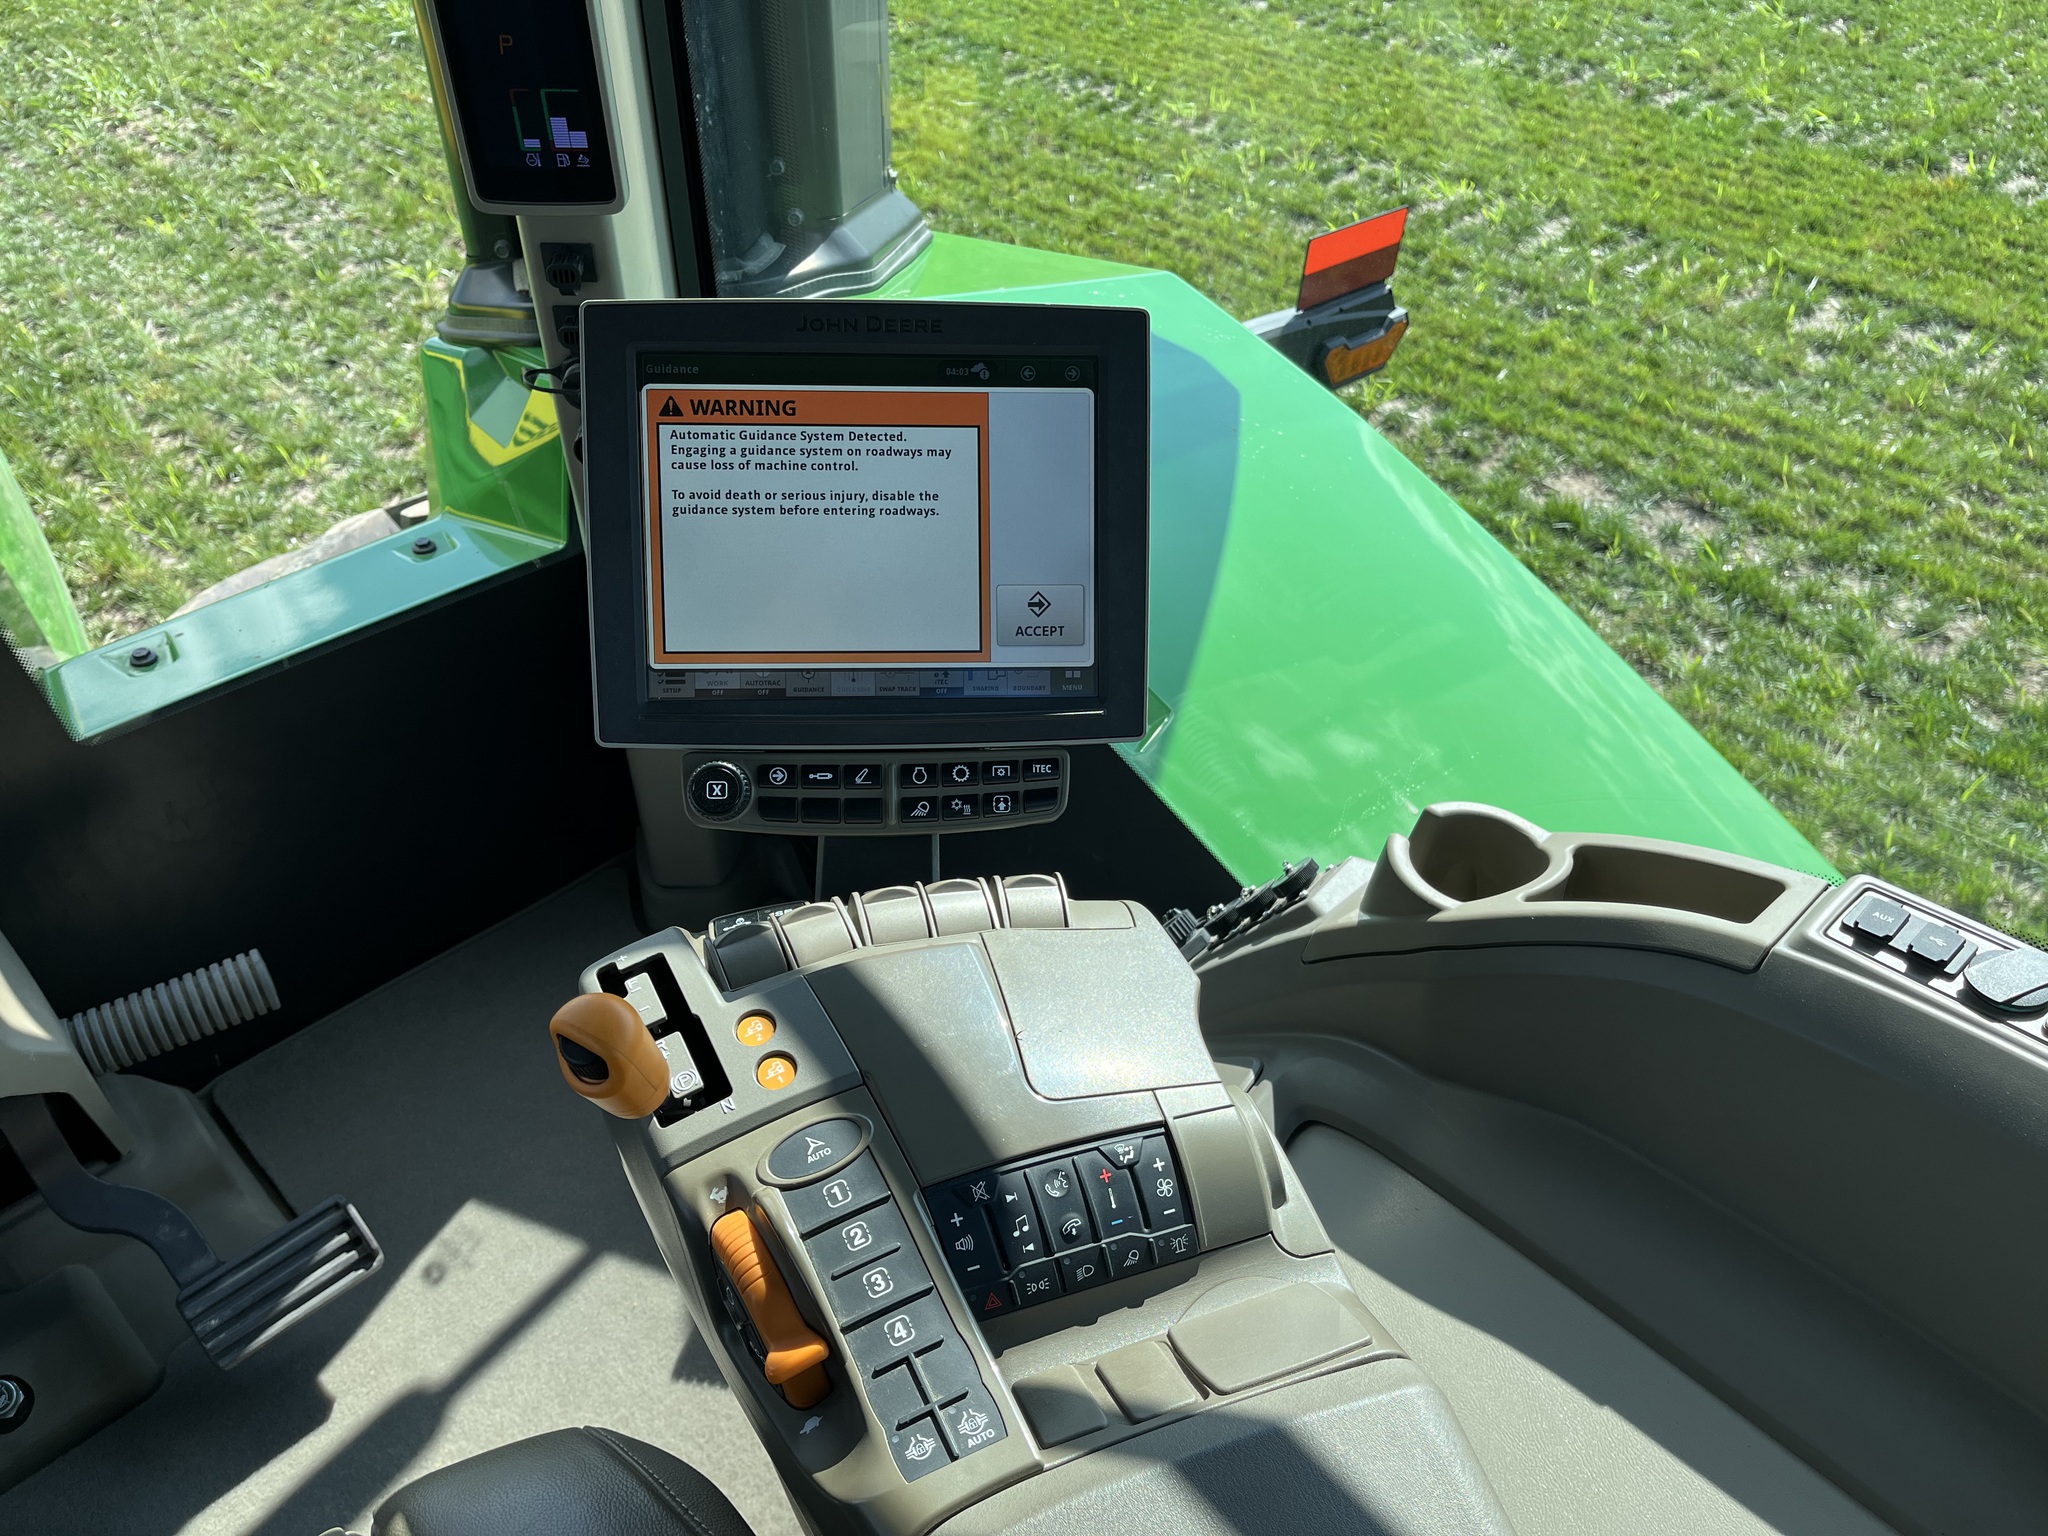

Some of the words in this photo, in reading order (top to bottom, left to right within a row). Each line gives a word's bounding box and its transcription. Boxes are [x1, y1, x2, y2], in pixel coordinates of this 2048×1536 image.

[795, 315, 858, 333] JOHN
[865, 316, 943, 334] DEERE
[645, 364, 699, 374] Guidance
[945, 367, 969, 376] 04:03
[689, 399, 797, 417] WARNING
[669, 430, 736, 441] Automatic
[739, 430, 797, 441] Guidance
[800, 431, 844, 443] System
[848, 431, 907, 442] Detected.
[671, 445, 726, 457] Engaging
[729, 447, 737, 455] a
[740, 445, 796, 458] guidance
[799, 447, 843, 458] system
[846, 448, 862, 457] on
[865, 446, 923, 459] roadways
[926, 449, 952, 460] may
[671, 461, 707, 470] cause
[710, 460, 735, 471] loss
[738, 460, 752, 471] of
[754, 460, 807, 471] machine
[810, 461, 859, 471] control.
[671, 489, 685, 500] To
[688, 489, 721, 500] avoid
[725, 489, 761, 500] death
[764, 491, 778, 500] or
[781, 490, 826, 501] serious
[829, 490, 869, 503] injury,
[872, 490, 915, 501] disable
[918, 491, 939, 501] the
[672, 504, 728, 517] guidance
[731, 505, 775, 517] system
[779, 504, 820, 515] before
[823, 505, 876, 518] entering
[879, 505, 940, 518] roadways.
[1015, 625, 1065, 637] ACCEPT
[1032, 764, 1052, 774] iTEC
[1871, 911, 1895, 924] AUX
[720, 1097, 737, 1115] N
[807, 1146, 832, 1164] AUTO
[830, 1185, 844, 1202] 1
[850, 1228, 864, 1245] 2
[870, 1274, 886, 1292] 3
[893, 1322, 907, 1339] 4
[966, 1427, 996, 1449] AUTO
